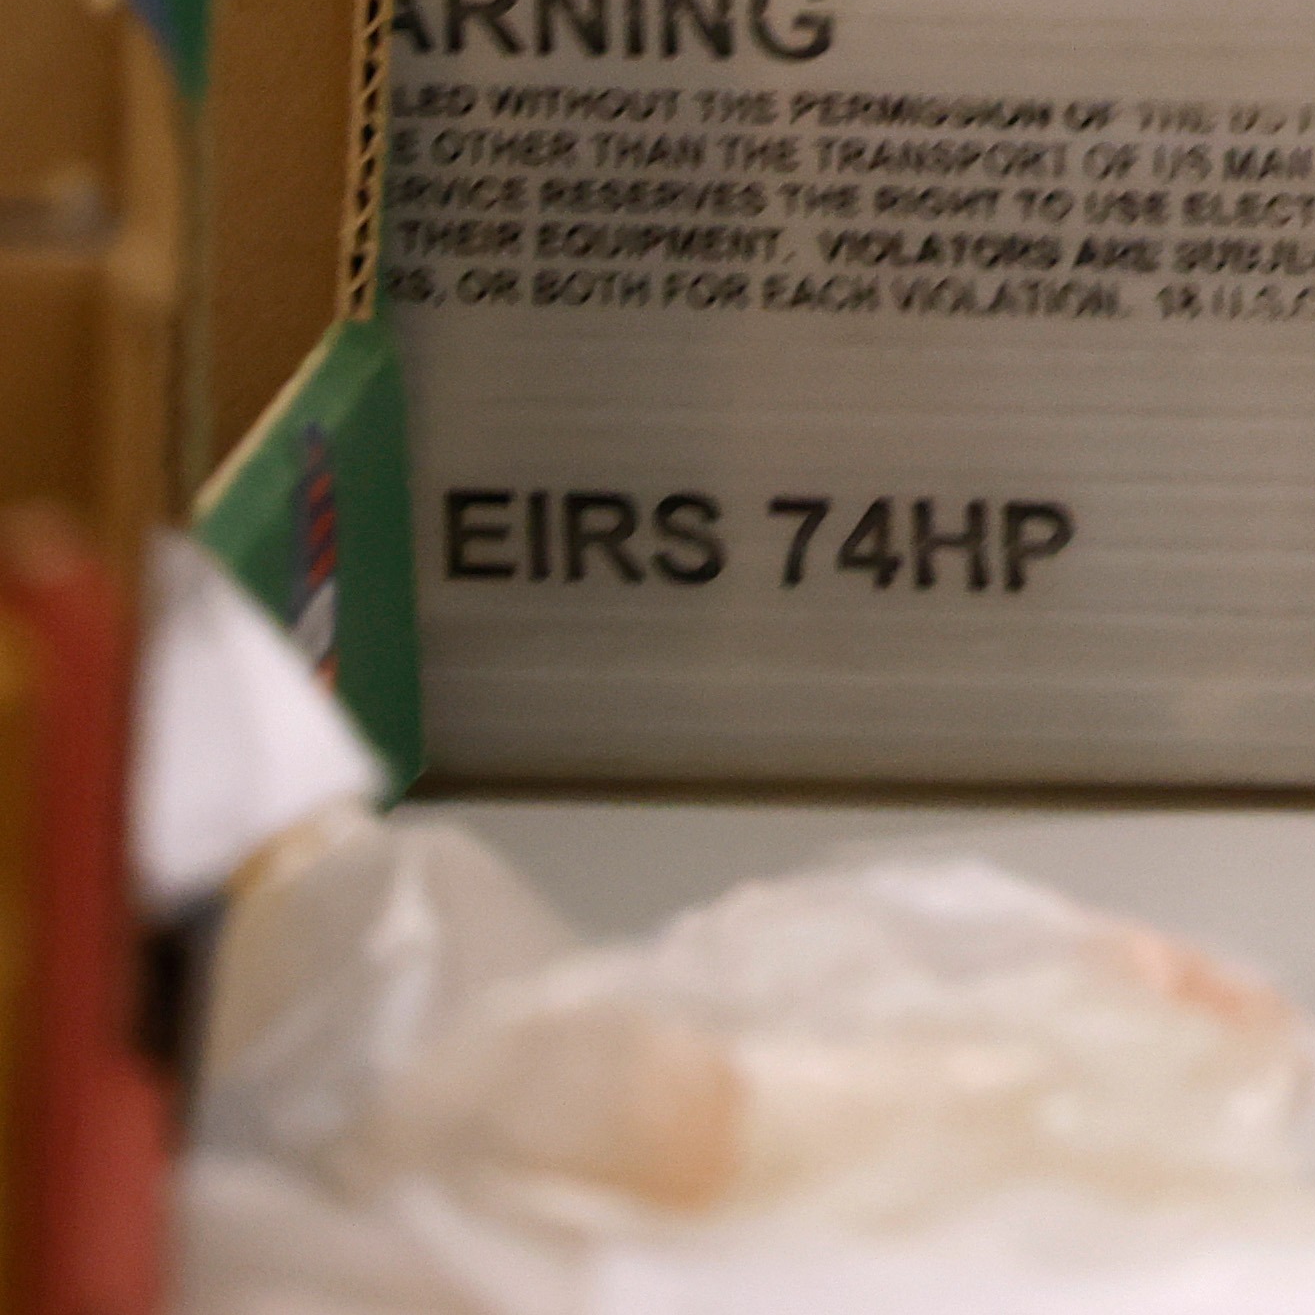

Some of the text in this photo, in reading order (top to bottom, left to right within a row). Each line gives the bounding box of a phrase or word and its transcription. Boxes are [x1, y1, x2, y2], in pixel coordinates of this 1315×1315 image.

[491, 84, 681, 121] WITHOUT
[697, 87, 778, 125] THE
[791, 90, 1053, 131] PERMISSION
[1064, 100, 1117, 133] OF
[430, 129, 577, 167] OTHER
[593, 132, 706, 169] THAN
[716, 134, 800, 173] THE
[816, 136, 1068, 177] TRANSPORT
[1082, 142, 1138, 181] OF
[539, 177, 768, 218] RESERVES
[776, 182, 861, 219] THE
[873, 184, 1001, 222] RIGHT
[1013, 187, 1075, 225] TO
[1084, 189, 1170, 227] USE
[398, 219, 523, 258] THEIR
[816, 228, 1064, 269] VIOLATORS
[1071, 234, 1162, 273] ARE
[456, 269, 524, 308] OR
[532, 269, 652, 309] BOTH
[662, 272, 752, 311] FOR
[761, 274, 882, 314] EACH
[441, 488, 1082, 594] EIRS 74HP
